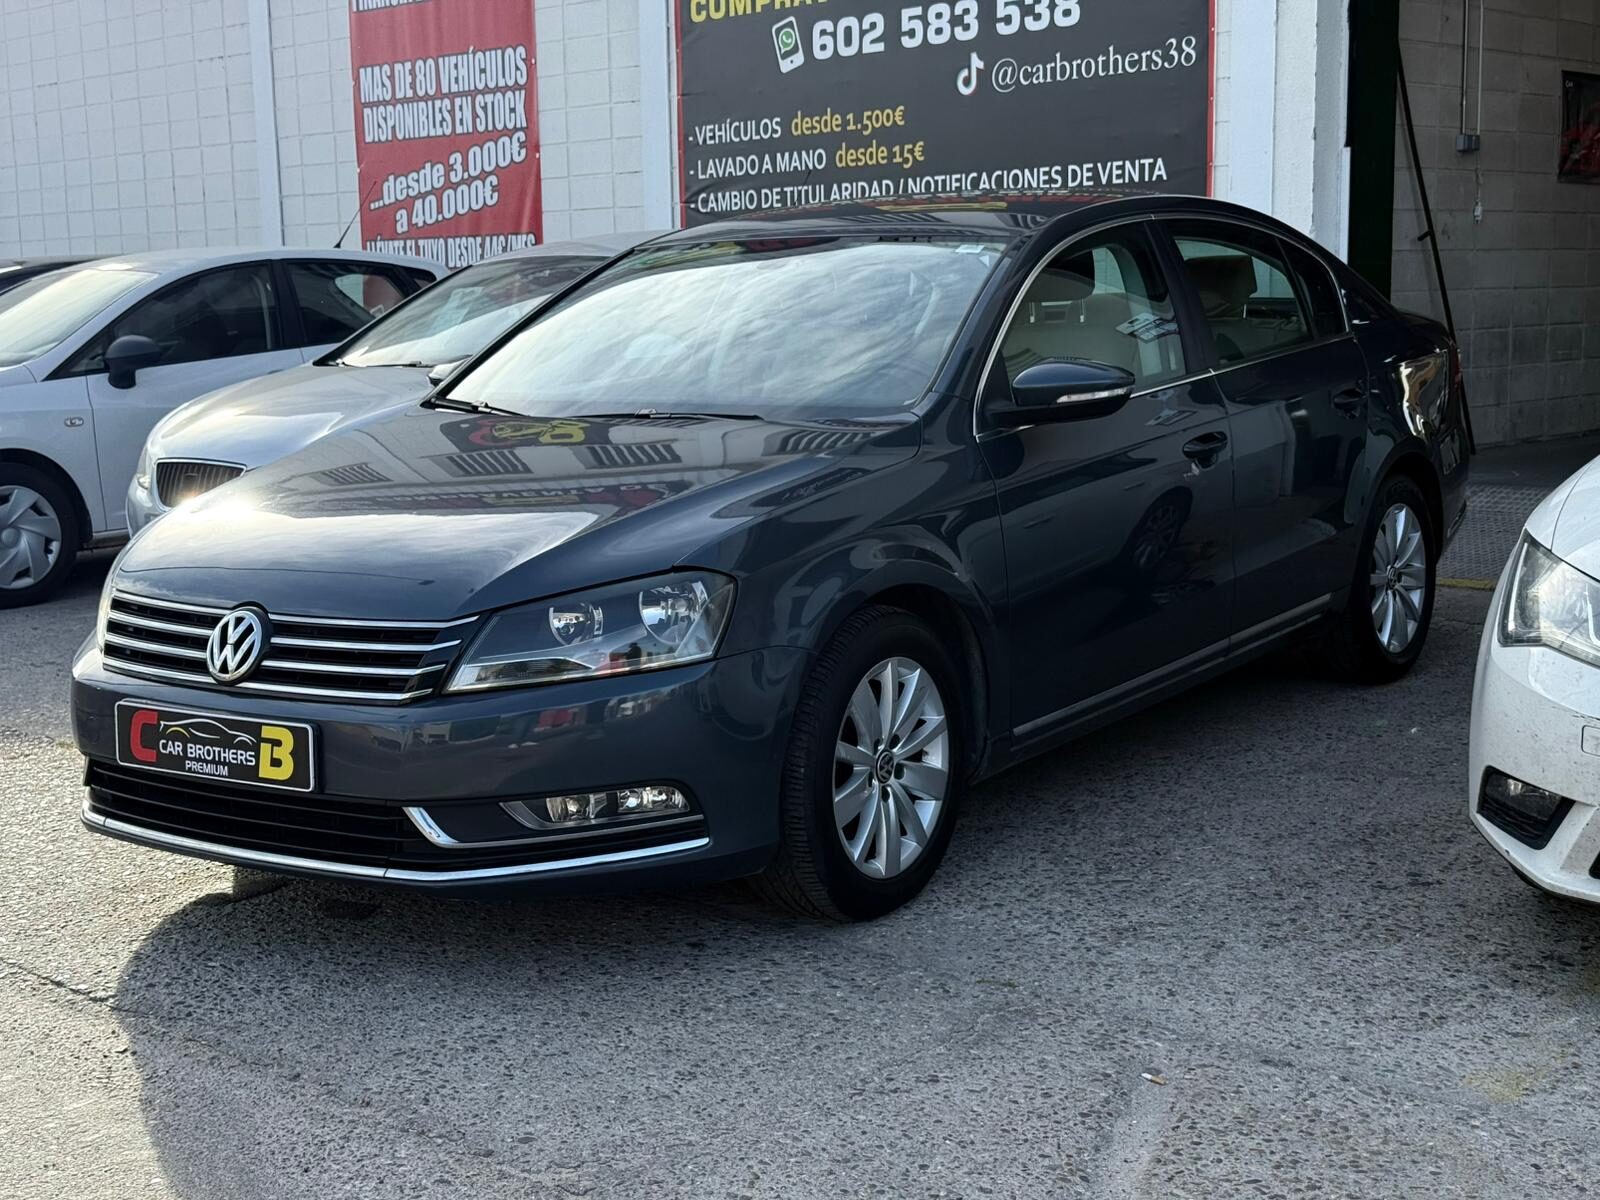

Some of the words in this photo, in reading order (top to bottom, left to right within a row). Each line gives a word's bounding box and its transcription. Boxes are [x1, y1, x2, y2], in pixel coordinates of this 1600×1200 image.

[812, 12, 885, 60] 602
[900, 0, 979, 49] 583
[995, 0, 1081, 35] 538
[359, 64, 392, 103] MAS
[394, 61, 413, 100] DE
[415, 58, 437, 97] 80
[438, 45, 528, 95] VEHÍCULOS
[991, 35, 1197, 93] @carbrothers38
[363, 97, 453, 143] DISPONIBLES
[455, 95, 473, 135] EN
[475, 89, 527, 133] STOCK
[791, 107, 842, 136] desde
[846, 105, 905, 136] 1.500€
[449, 131, 526, 184] 3.000€
[761, 157, 774, 175] A
[776, 148, 827, 172] MANO
[835, 139, 888, 168] desde
[891, 141, 925, 169] 15€
[761, 187, 782, 209] DE
[783, 179, 895, 207] TITULARIDAD
[907, 165, 1063, 194] NOTIFICACIONES
[1067, 164, 1095, 188] DE
[1097, 156, 1168, 185] VENTA
[395, 208, 409, 234] a
[411, 174, 499, 228] 40.000€
[159, 739, 184, 757] CAR
[186, 742, 257, 767] BROTHERS
[185, 759, 229, 777] PREMIUM
